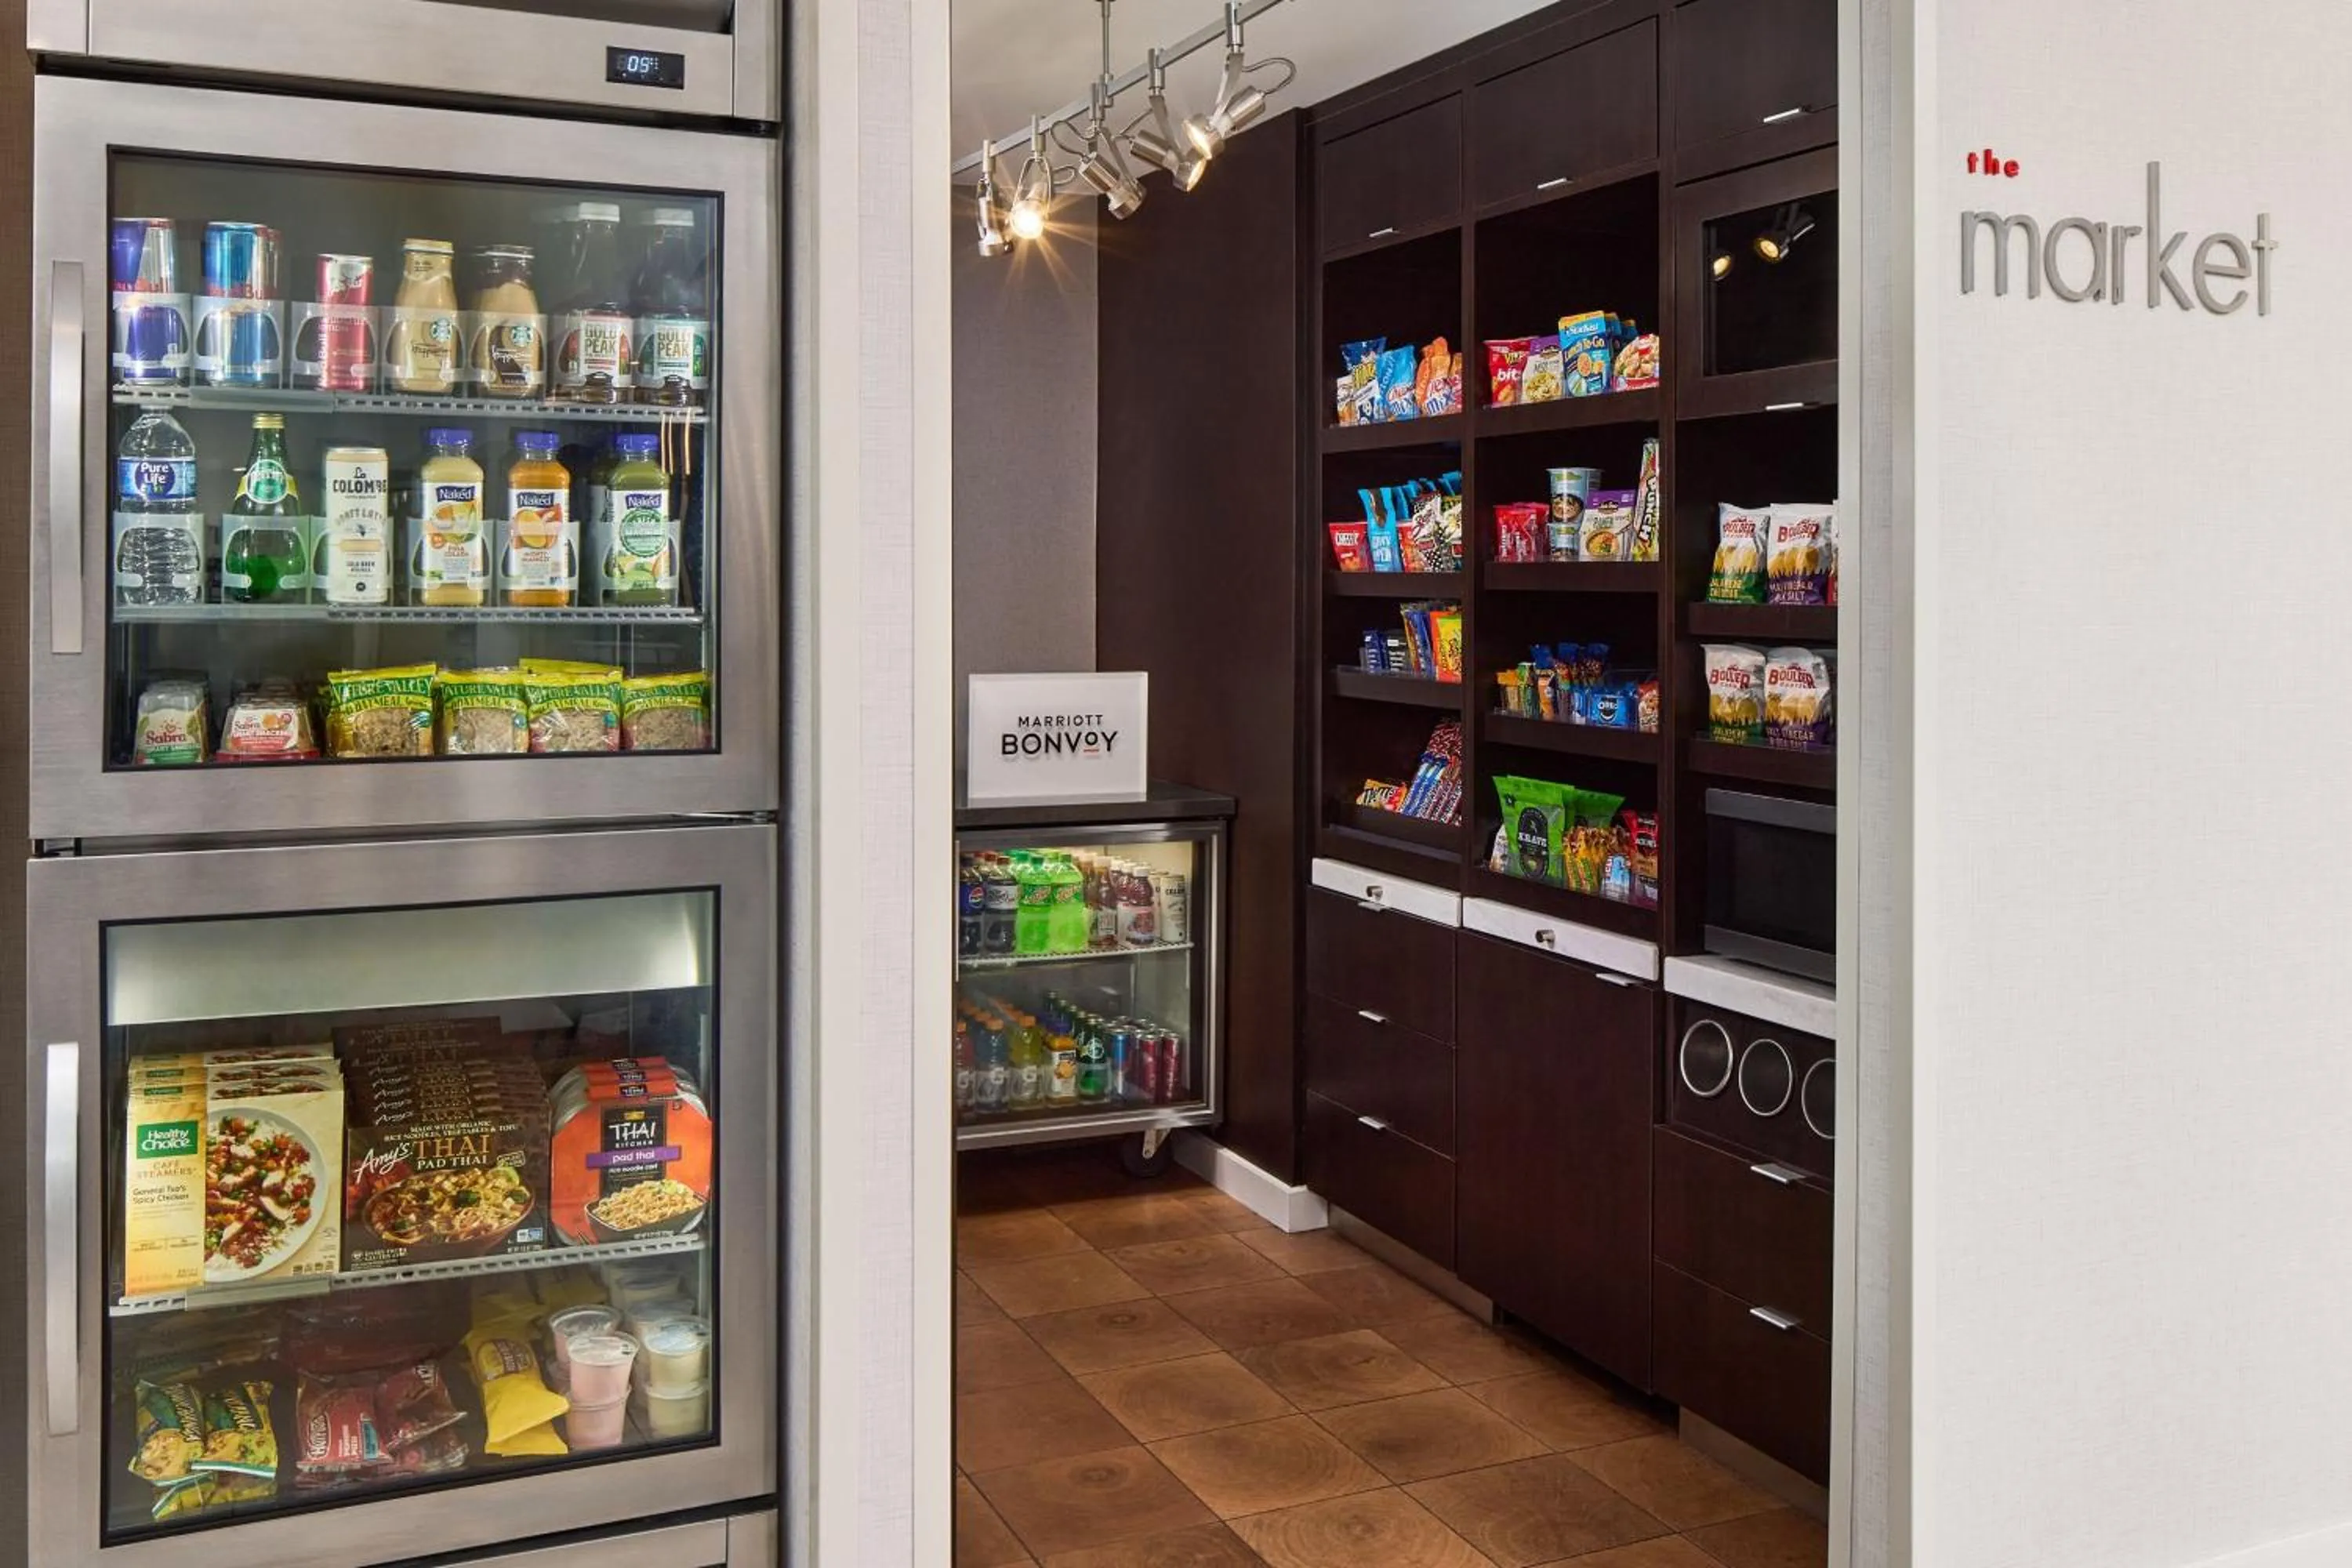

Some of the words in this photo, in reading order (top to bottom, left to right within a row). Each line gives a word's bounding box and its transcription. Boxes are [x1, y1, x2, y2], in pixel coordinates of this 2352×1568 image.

[1967, 149, 2020, 178] the
[1960, 161, 2279, 317] market
[585, 338, 617, 353] PEAK
[140, 462, 169, 473] Pure
[143, 473, 166, 486] Life
[332, 479, 387, 494] COLOMBE
[440, 488, 471, 500] Naked
[520, 494, 552, 506] Naked
[628, 496, 660, 507] Naked
[1018, 714, 1103, 728] MARRIOTT
[146, 730, 187, 745] Sabra
[1002, 731, 1118, 755] BONVOY
[148, 1128, 189, 1141] Healthy
[608, 1120, 657, 1141] THAI
[141, 1138, 191, 1152] Choice
[413, 1134, 490, 1160] THAI
[354, 1142, 413, 1185] Amy's
[417, 1159, 447, 1171] PAD
[451, 1154, 488, 1167] THAI
[612, 1152, 634, 1164] pad
